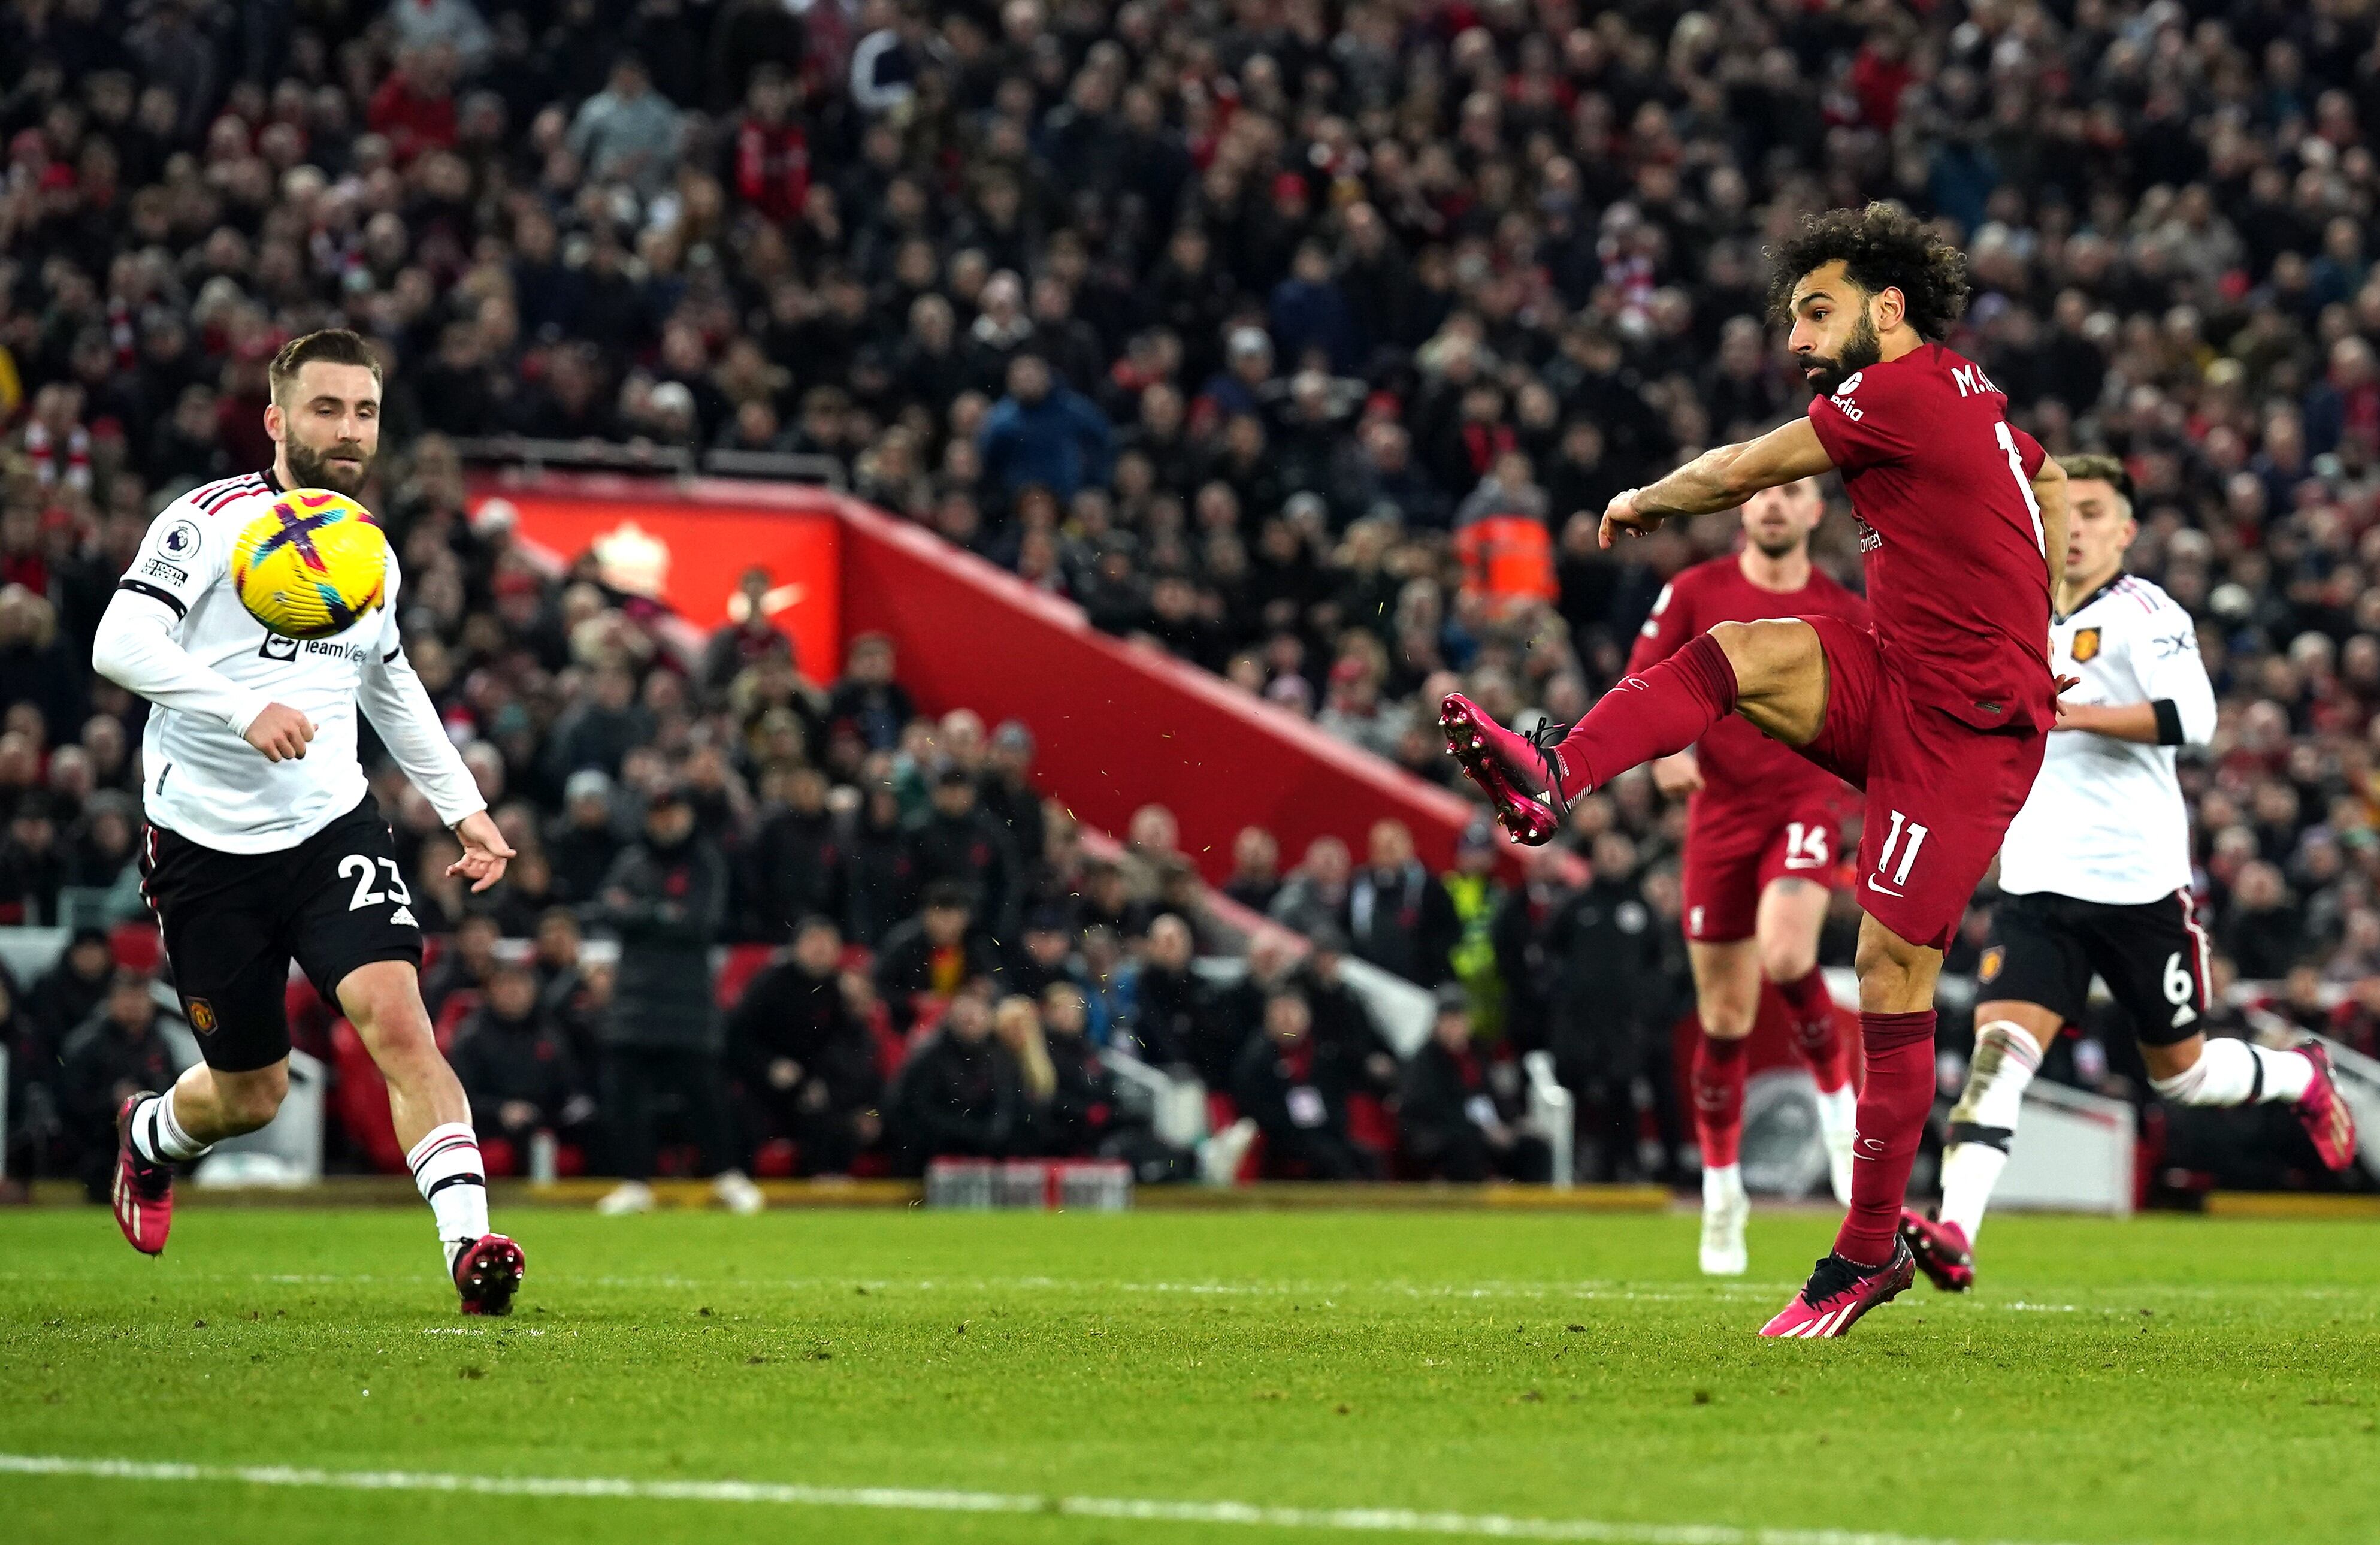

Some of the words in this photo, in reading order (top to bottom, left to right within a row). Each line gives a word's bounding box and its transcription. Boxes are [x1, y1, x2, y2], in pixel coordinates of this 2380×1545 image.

[156, 563, 183, 580] room
[1878, 809, 1928, 887] 11
[338, 854, 412, 911] 23
[2163, 951, 2194, 1005] 6
